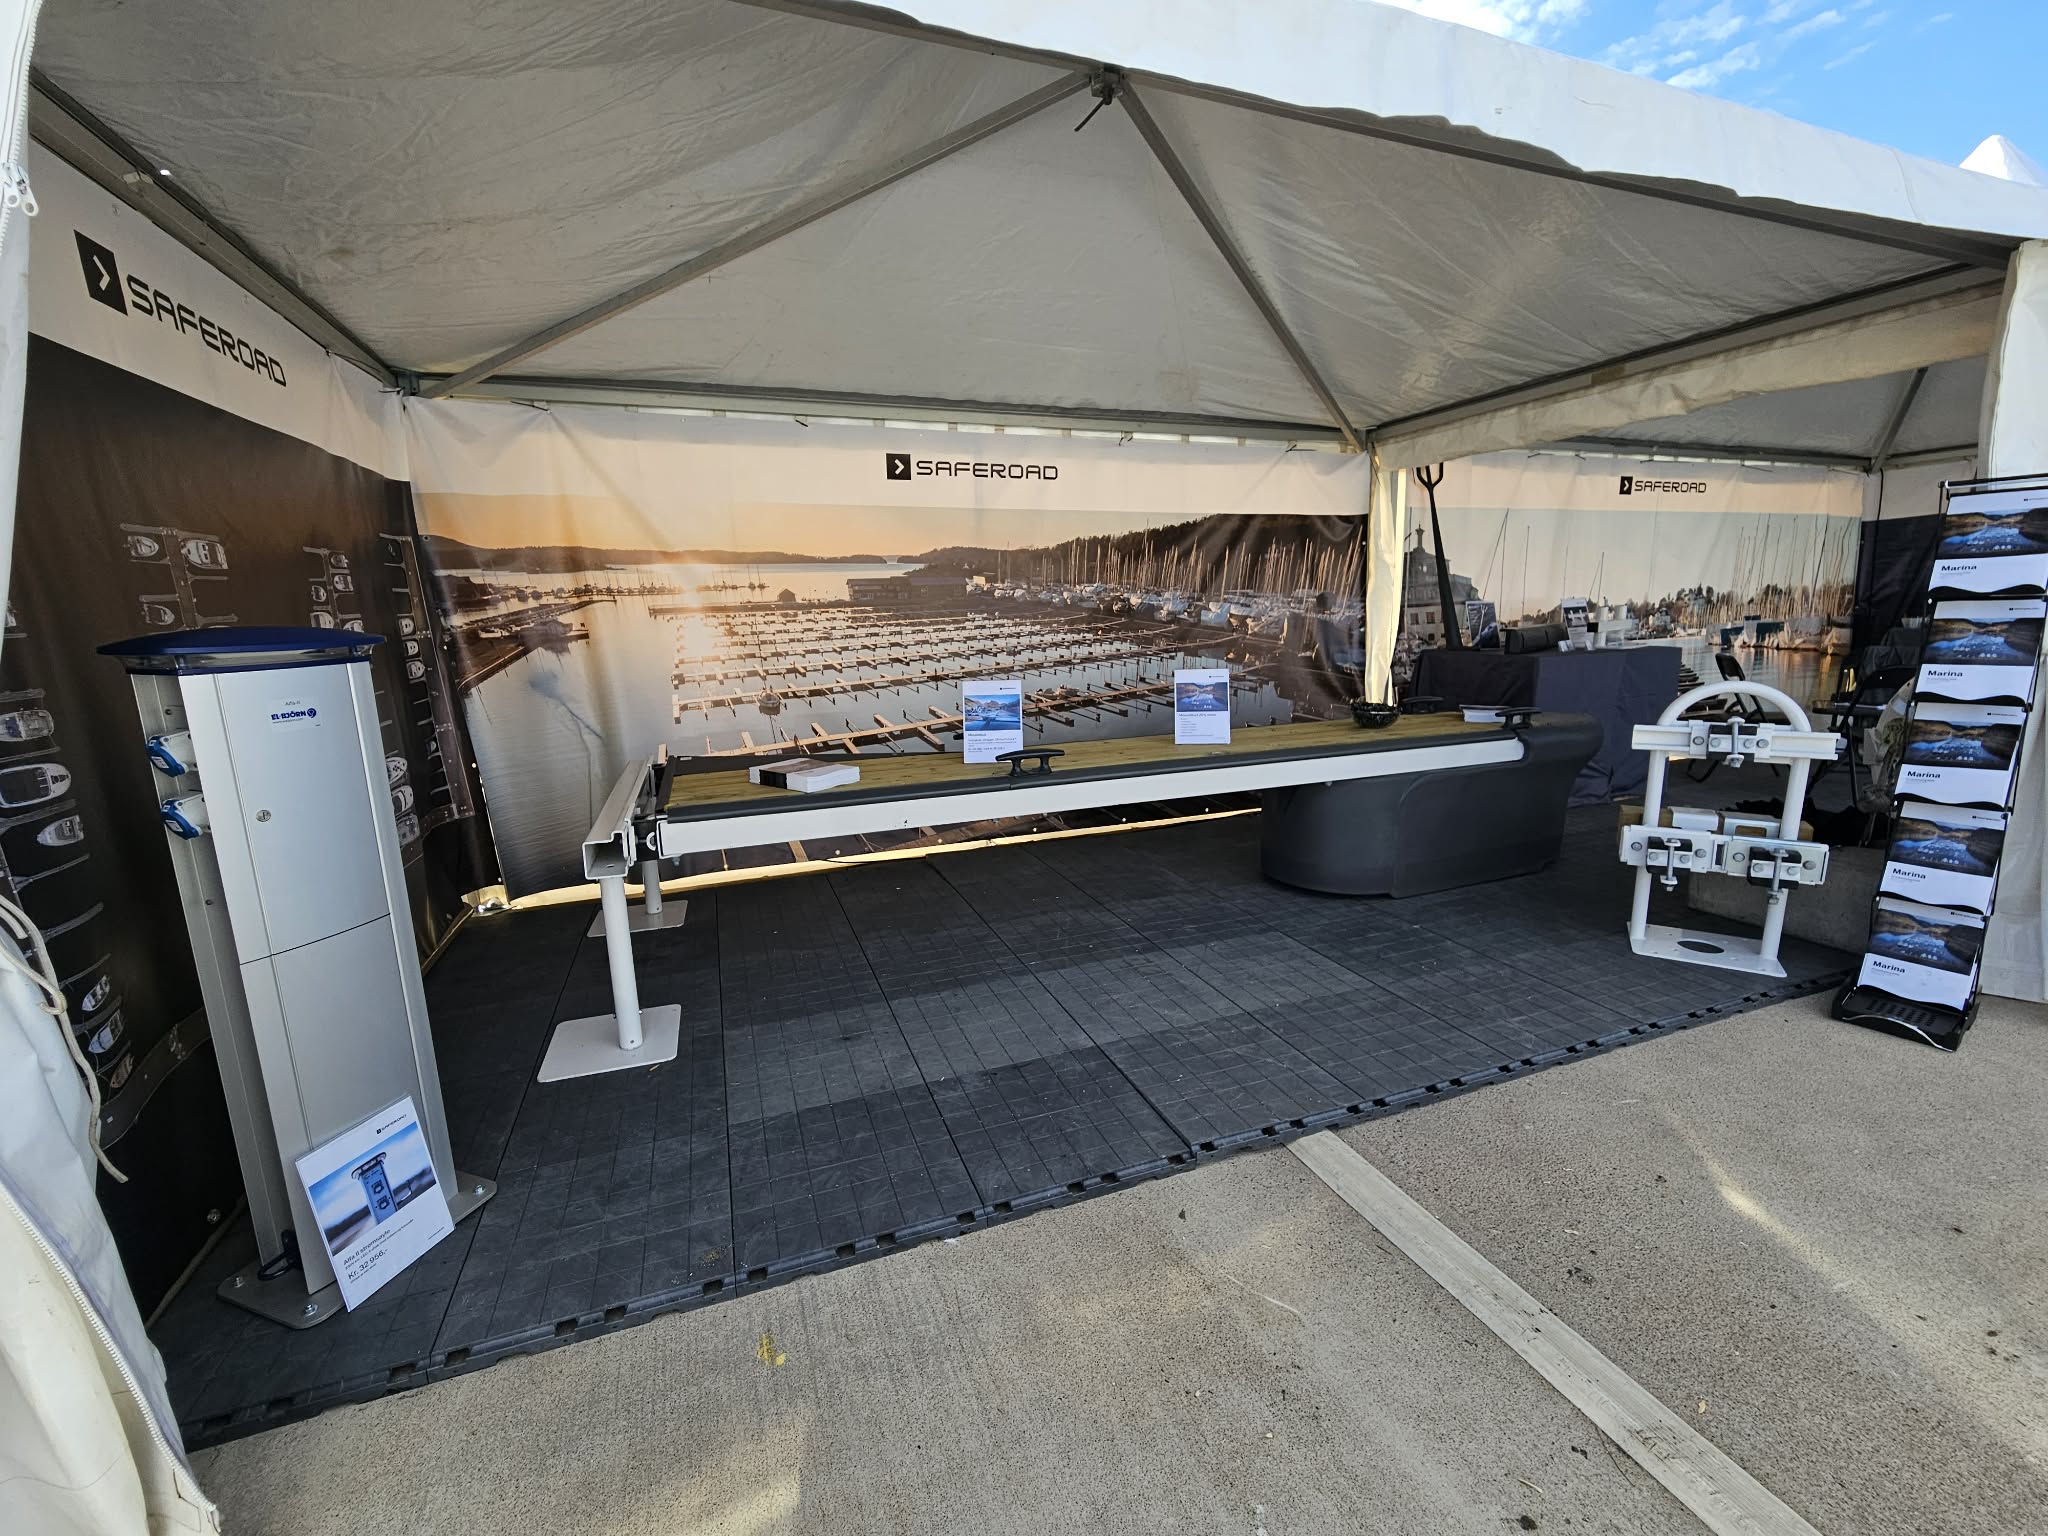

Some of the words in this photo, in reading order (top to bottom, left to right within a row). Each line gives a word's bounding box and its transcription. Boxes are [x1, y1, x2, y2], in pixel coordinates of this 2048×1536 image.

[126, 273, 287, 387] SAFEROAD
[916, 460, 1058, 480] SAFEROAD
[1634, 480, 1707, 493] SAFEROAD
[1907, 770, 1941, 779] Marina
[1892, 868, 1926, 880] Marina
[1873, 960, 1905, 973] Marina
[348, 1269, 359, 1280] Kr.
[359, 1261, 370, 1272] 32
